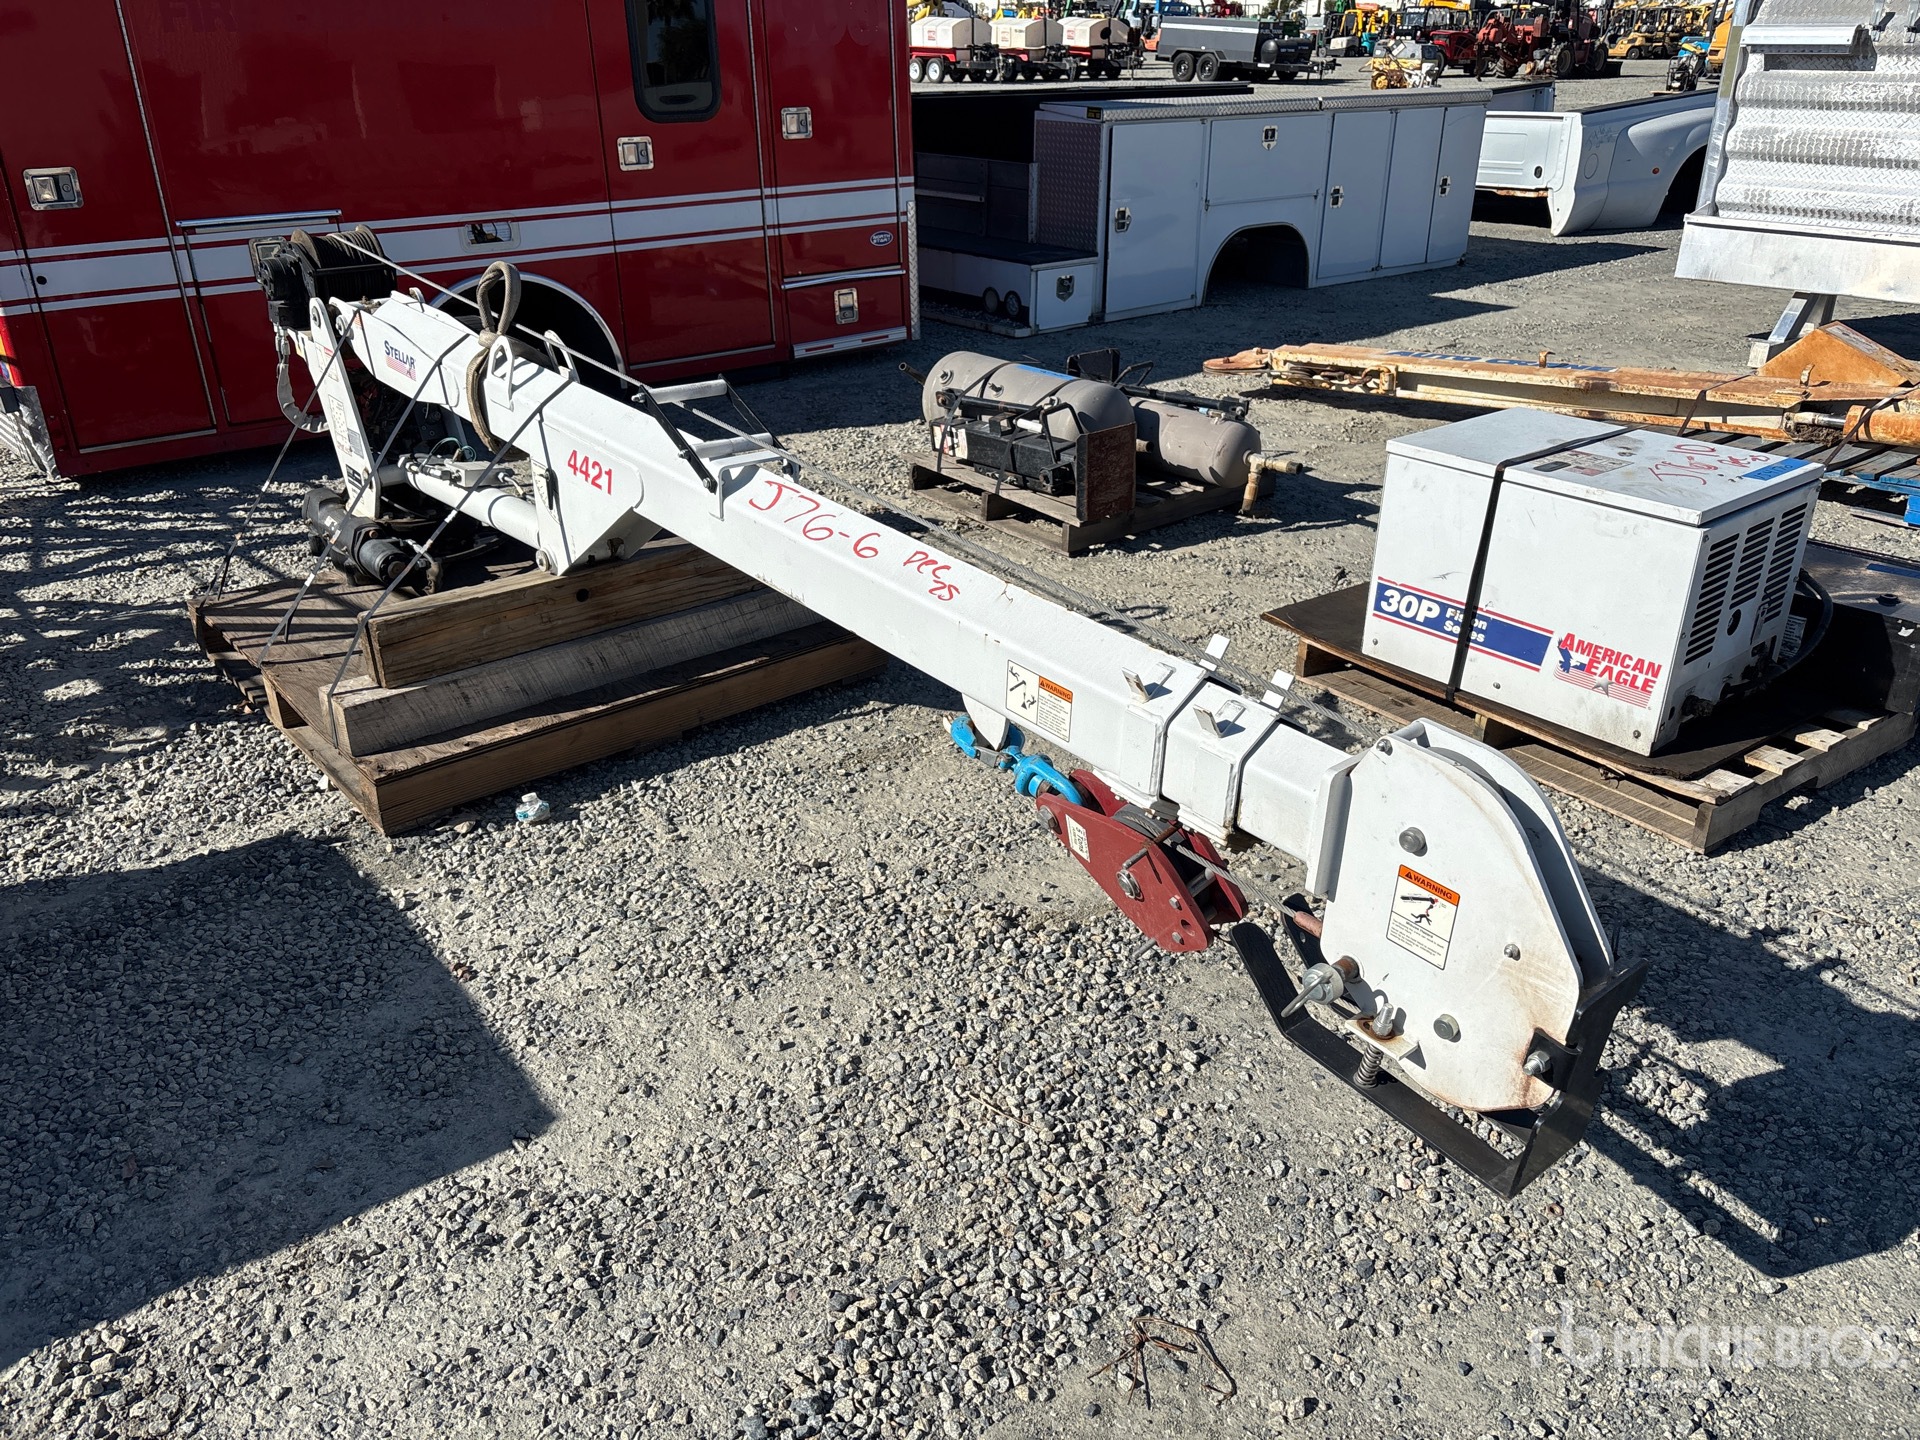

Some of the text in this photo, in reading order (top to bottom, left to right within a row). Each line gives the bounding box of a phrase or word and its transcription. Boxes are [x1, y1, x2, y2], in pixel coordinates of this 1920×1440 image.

[384, 340, 416, 370] STELLAR
[567, 449, 613, 496] 4421
[748, 480, 882, 559] J76-6
[1380, 588, 1488, 630] 30P Pison
[1443, 620, 1486, 643] Sees
[1560, 632, 1662, 679] AMERICAN
[1045, 683, 1071, 700] WARNING
[1584, 657, 1657, 694] EAGLE
[1413, 874, 1453, 900] WARNING
